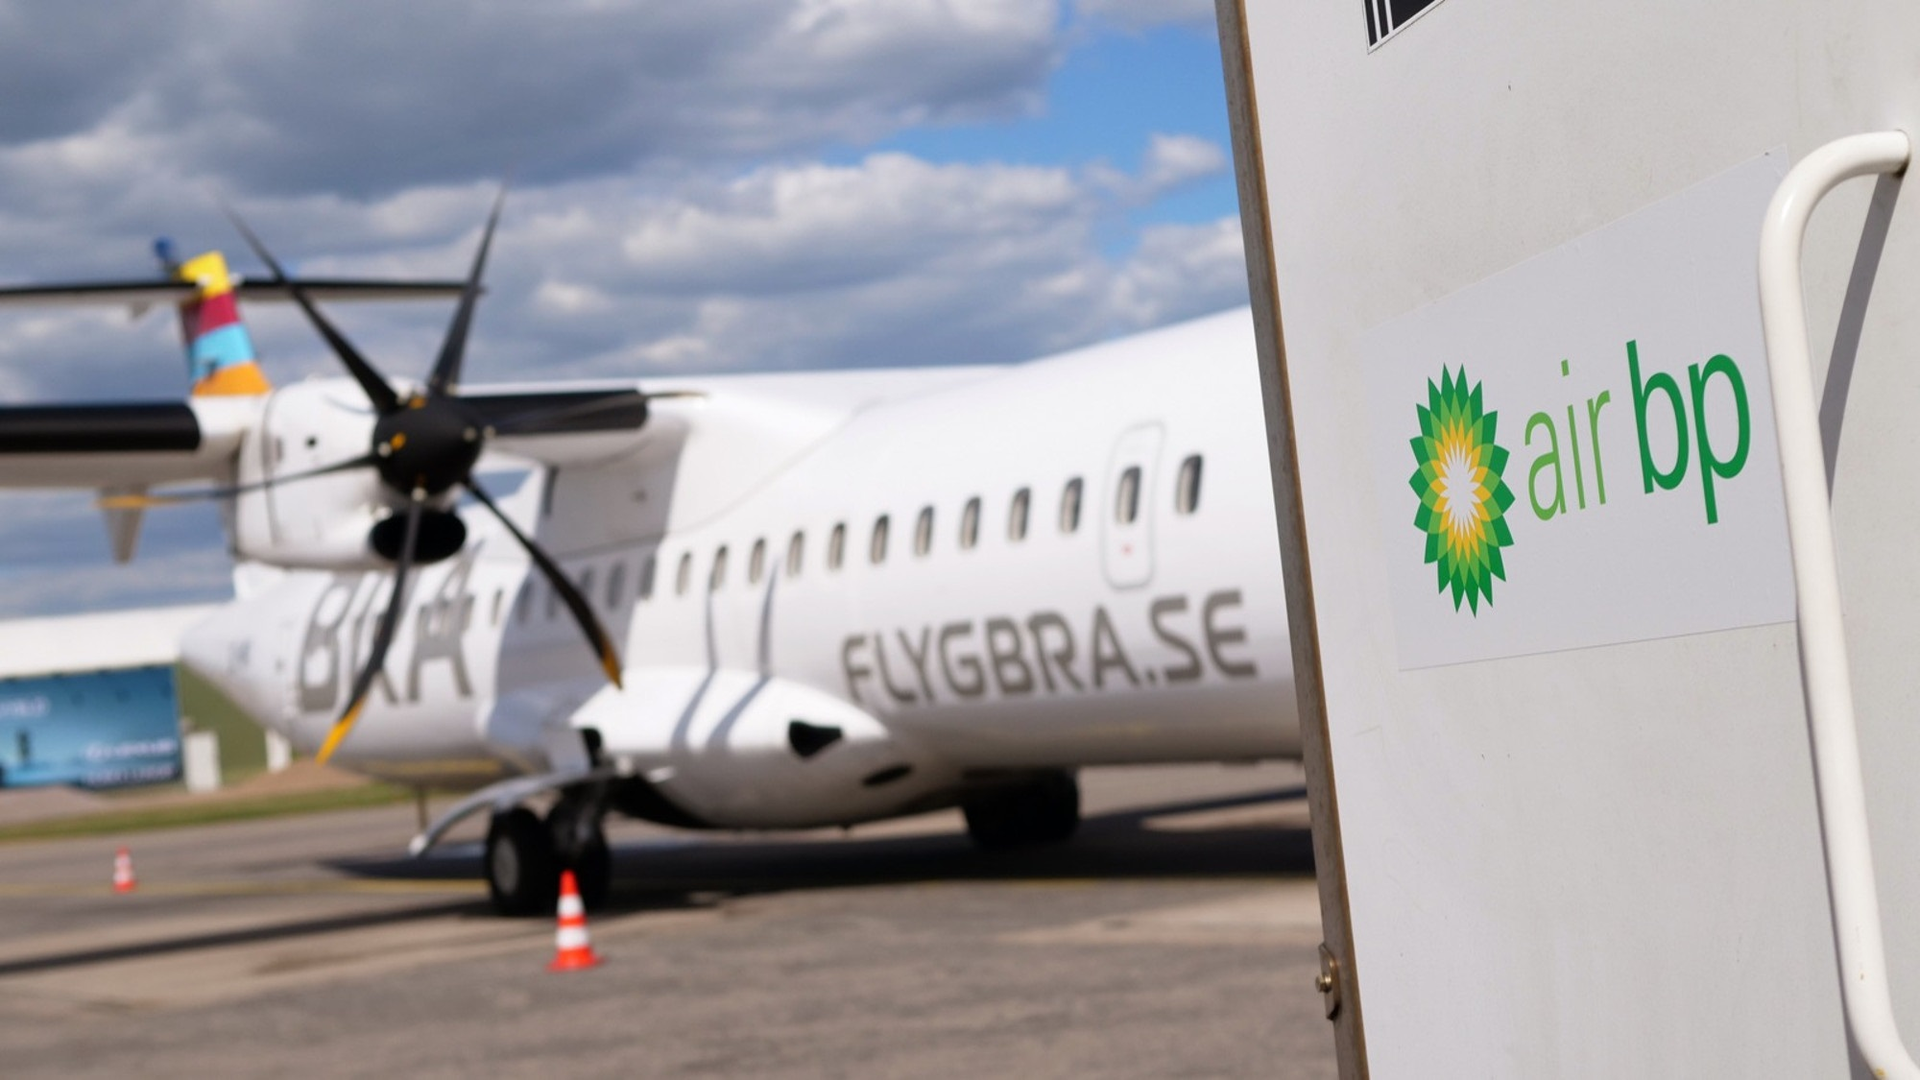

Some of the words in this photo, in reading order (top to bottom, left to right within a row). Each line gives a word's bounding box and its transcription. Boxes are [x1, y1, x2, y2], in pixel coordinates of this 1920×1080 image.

[1524, 359, 1611, 521] air
[1626, 339, 1751, 525] bp
[840, 588, 1258, 704] FLYGBRA.SE
